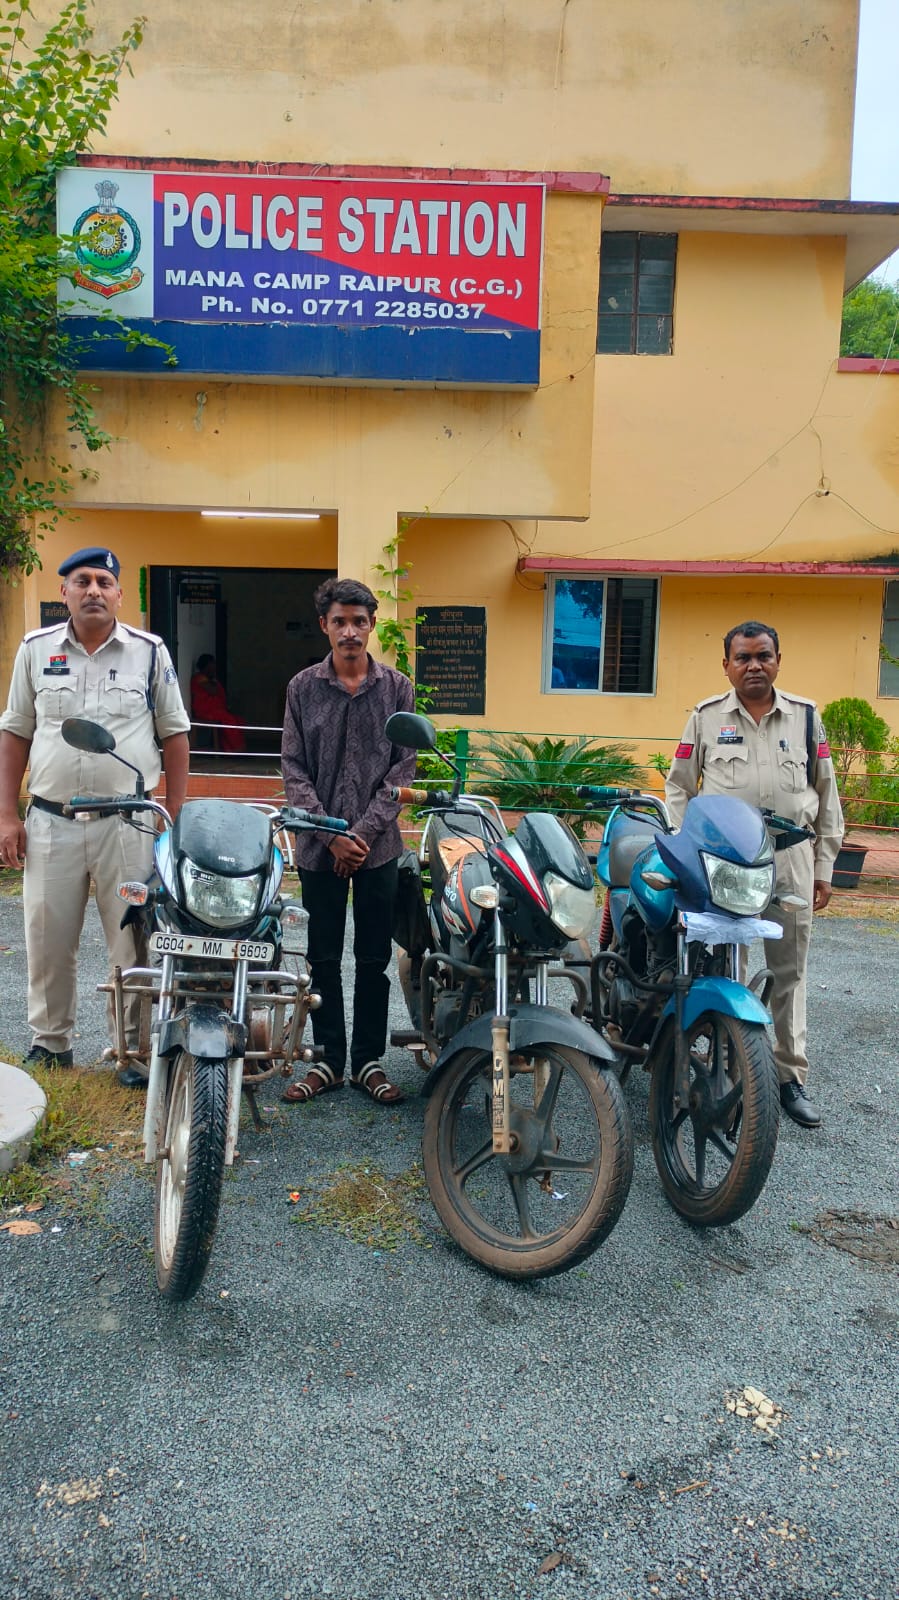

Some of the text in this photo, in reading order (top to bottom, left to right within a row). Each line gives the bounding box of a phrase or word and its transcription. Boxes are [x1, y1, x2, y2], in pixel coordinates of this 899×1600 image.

[163, 191, 527, 257] POLICE STATION
[165, 269, 523, 299] MANA CAMP RAIPUR (C.G.)
[202, 295, 486, 320] Ph. No. 0771 2285037
[156, 936, 268, 959] CG04 MM 9603
